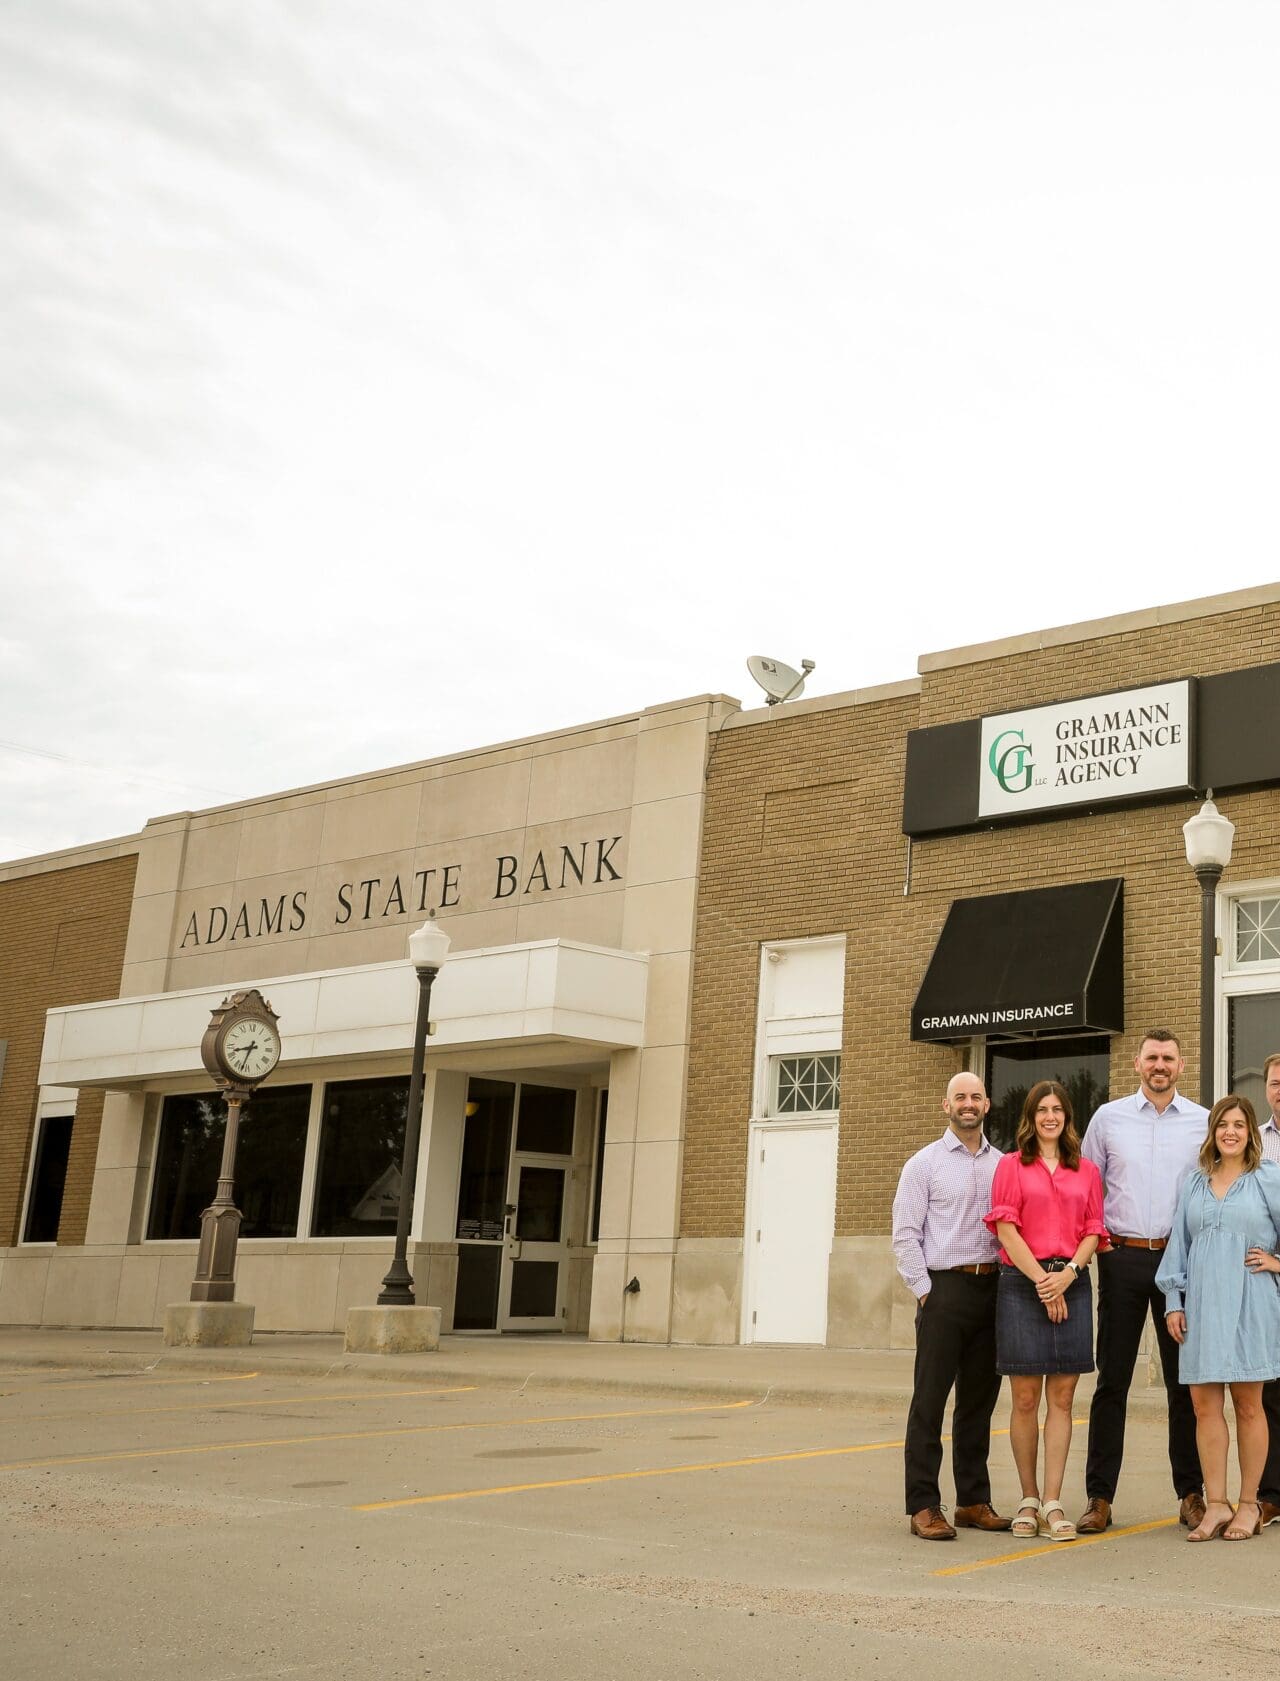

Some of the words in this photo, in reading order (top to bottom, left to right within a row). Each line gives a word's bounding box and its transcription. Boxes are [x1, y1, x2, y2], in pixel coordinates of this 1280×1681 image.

[1056, 702, 1170, 740] GRAMANN
[1056, 724, 1181, 763] INSURANCE
[1055, 755, 1142, 787] AGENCY
[179, 891, 307, 949] ADAMS
[335, 864, 462, 925] STATE
[492, 836, 623, 899] BANK
[921, 1012, 989, 1029] GRAMANN
[992, 1003, 1074, 1023] INSURANCE
